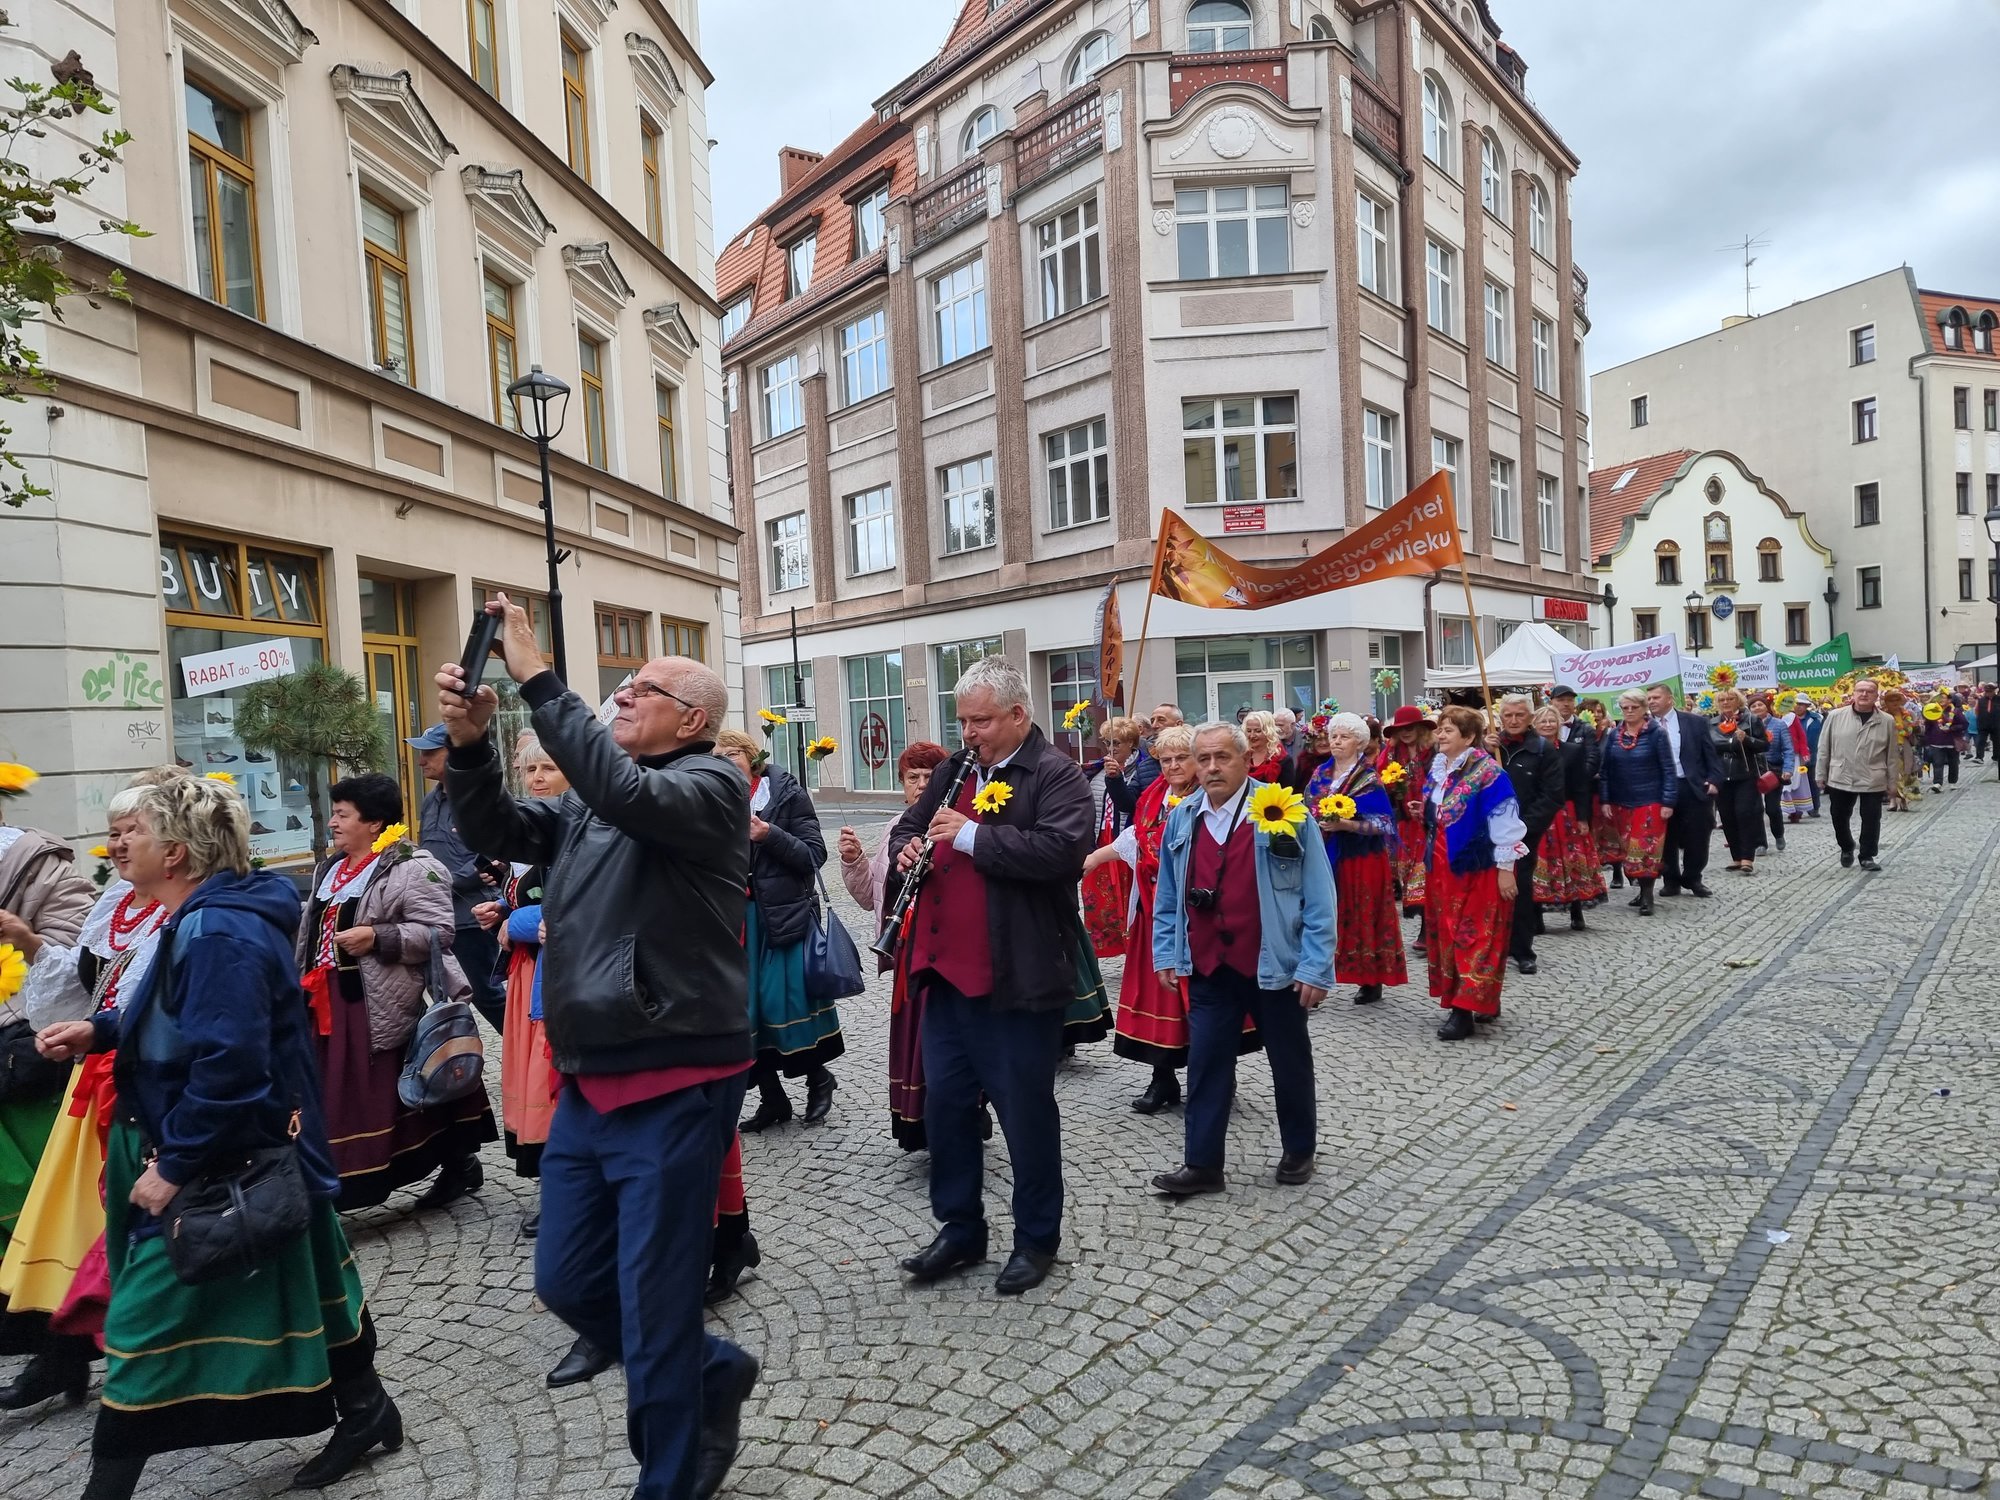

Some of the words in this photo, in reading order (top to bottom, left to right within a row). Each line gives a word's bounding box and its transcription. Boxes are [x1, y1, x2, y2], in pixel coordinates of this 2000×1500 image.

[1383, 530, 1452, 566] Wieku
[160, 555, 299, 610] BUTY
[188, 662, 235, 687] RABAT
[238, 665, 250, 677] do
[253, 649, 290, 671] -80%
[1559, 643, 1671, 673] Kowarskie
[1691, 663, 1711, 674] POLS
[1577, 669, 1652, 689] Wrzosy
[1683, 671, 1708, 680] EMERY
[1741, 673, 1769, 682] KOWARY
